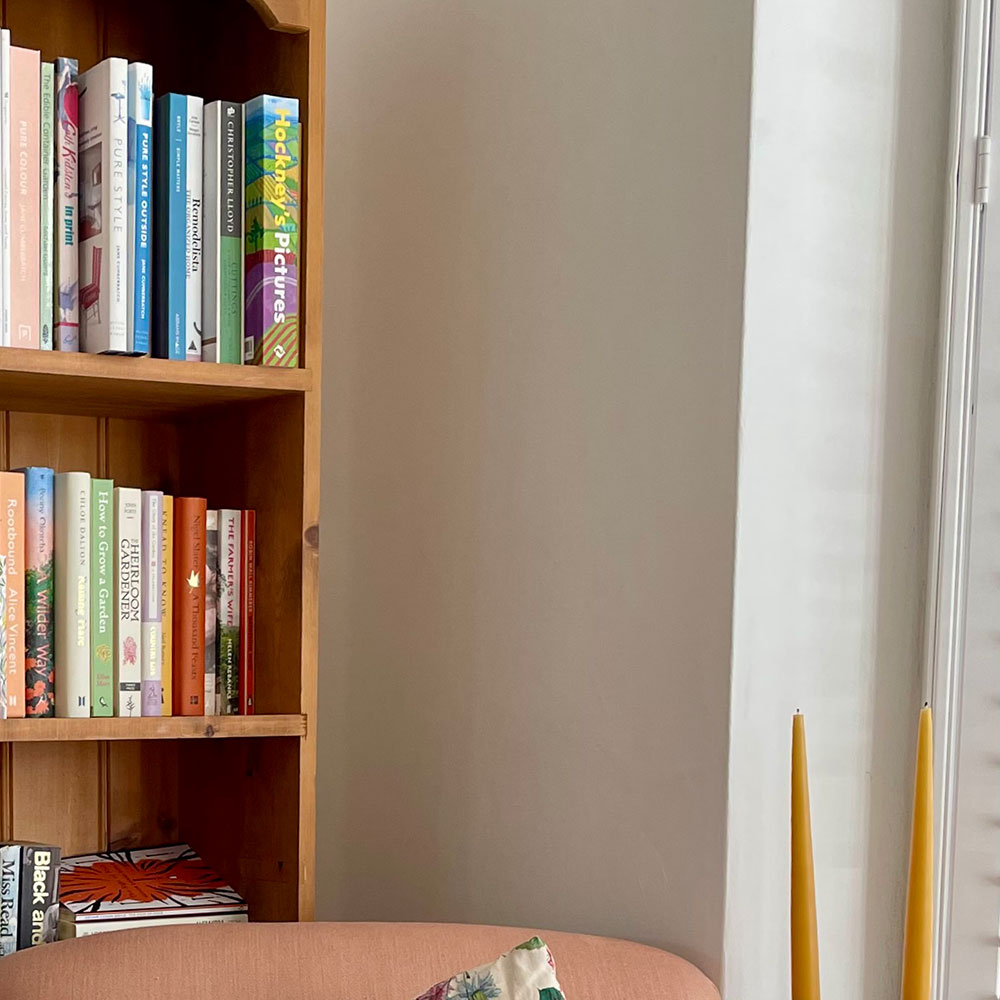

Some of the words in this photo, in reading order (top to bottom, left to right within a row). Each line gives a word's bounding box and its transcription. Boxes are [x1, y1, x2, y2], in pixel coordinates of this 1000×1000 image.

[20, 151, 28, 195] COLOUR
[114, 138, 122, 178] PURE
[268, 108, 291, 226] Hockney's
[113, 186, 123, 233] STYLE
[140, 200, 148, 248] OUTSIDE
[192, 199, 200, 272] Remodelista
[274, 232, 290, 324] Pictures
[98, 491, 109, 523] How
[6, 499, 17, 575] Rootbound
[98, 525, 107, 539] to
[36, 570, 49, 583] A
[98, 541, 109, 576] Grow
[121, 538, 130, 621] GARDENER
[8, 588, 18, 621] Alice
[130, 544, 139, 622] HEIRLOOM
[36, 589, 50, 643] Wilder
[98, 588, 109, 633] Garden
[8, 624, 18, 675] Vincent
[34, 644, 49, 677] Way
[0, 860, 15, 895] Miss
[0, 898, 14, 938] Read
